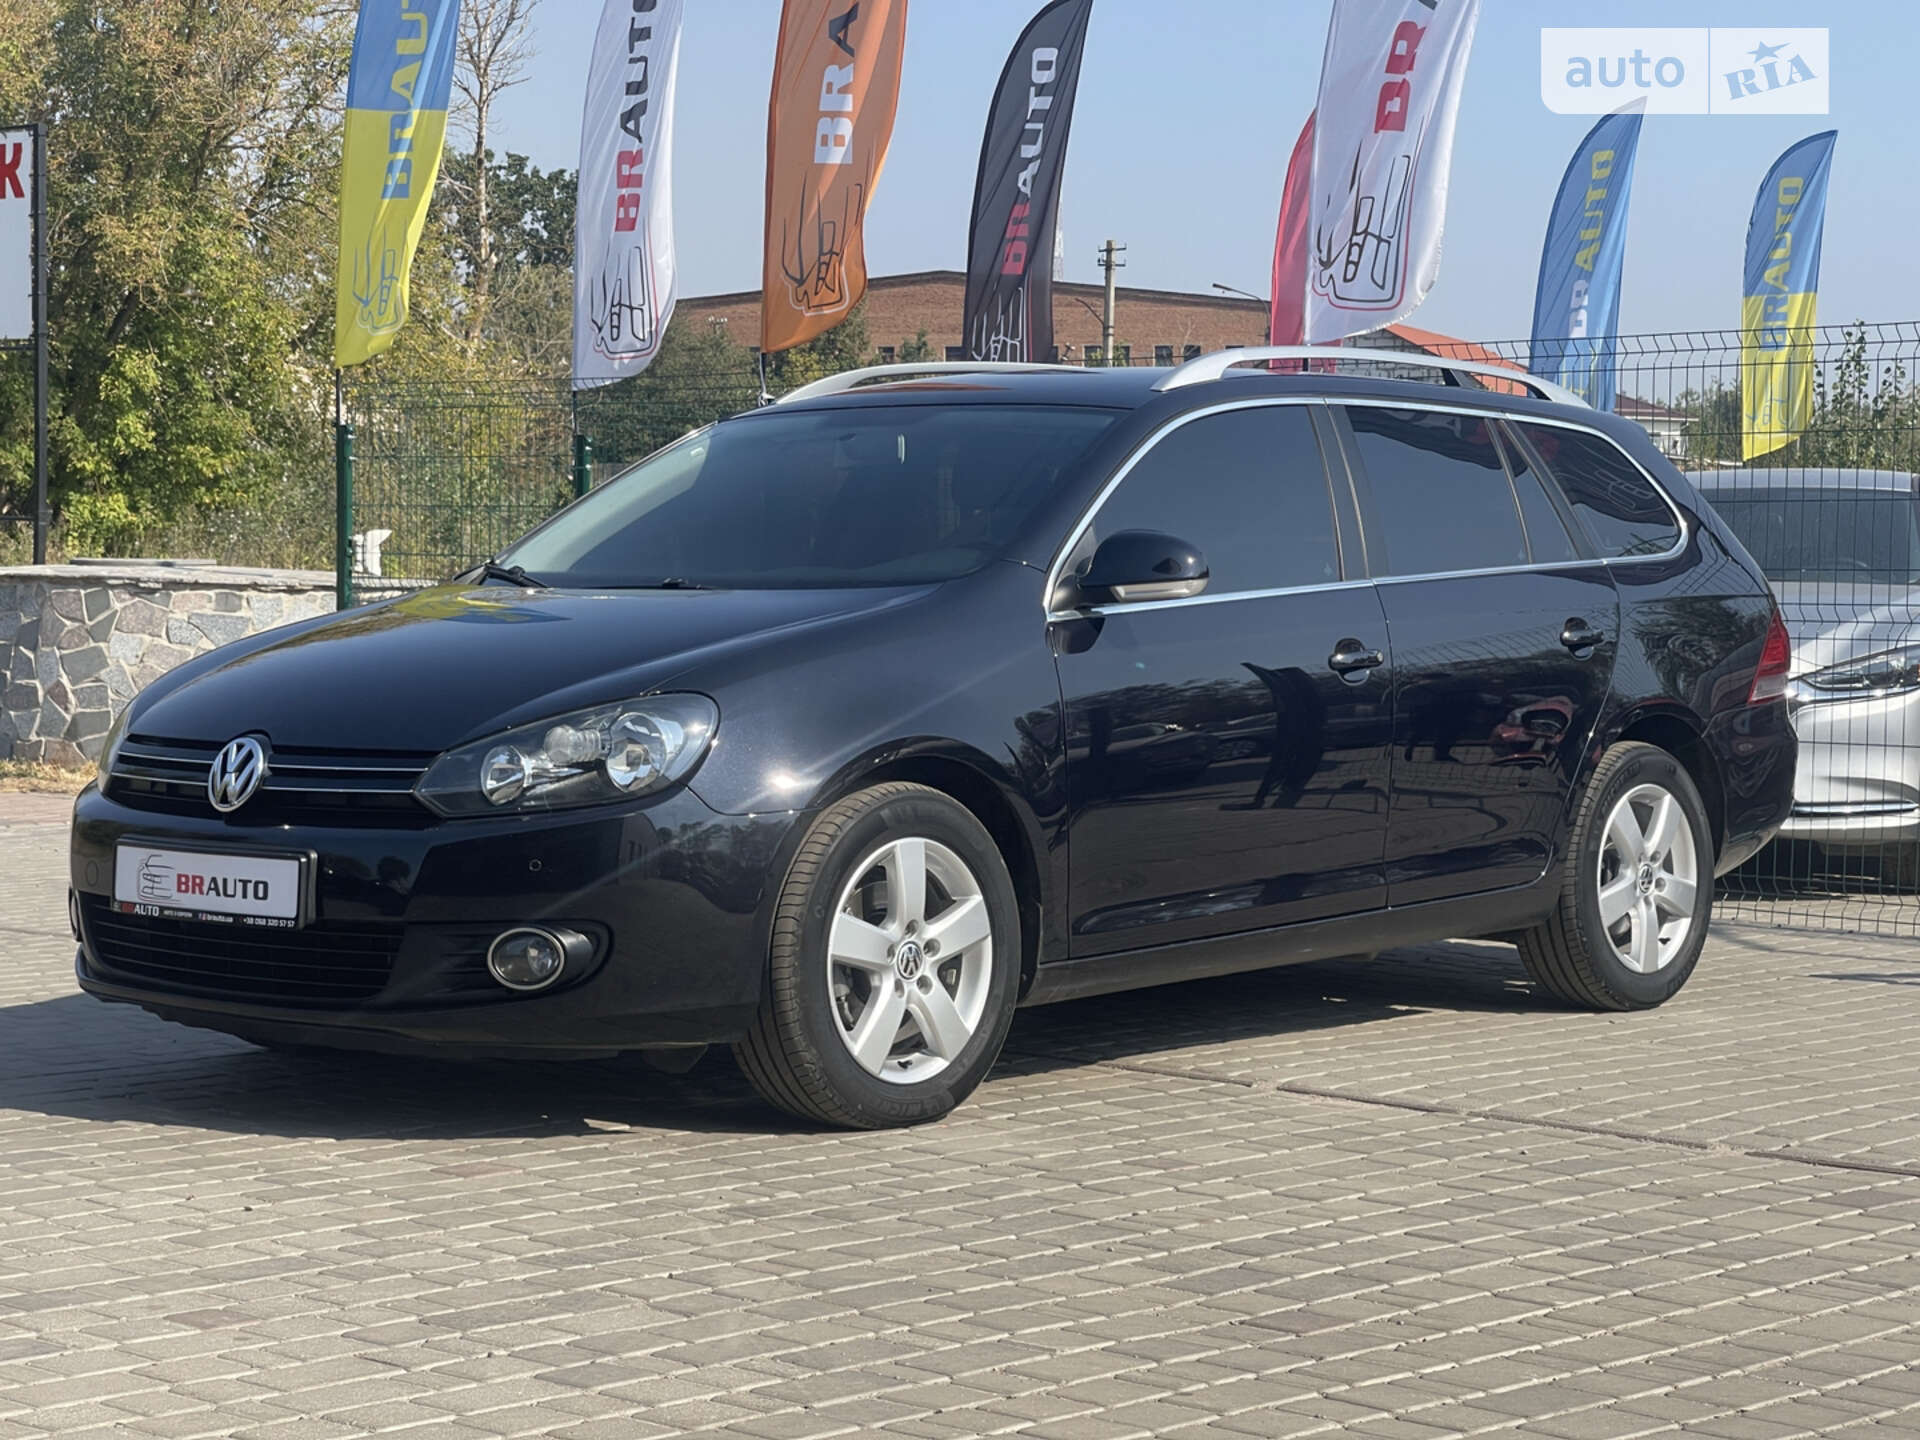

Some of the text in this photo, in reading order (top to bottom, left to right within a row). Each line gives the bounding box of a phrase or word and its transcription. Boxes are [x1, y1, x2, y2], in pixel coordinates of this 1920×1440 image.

[381, 0, 428, 199] BRAU
[1000, 47, 1059, 275] BRAUTO
[1760, 176, 1805, 352] BRAUTO
[176, 873, 269, 901] BRAUTO
